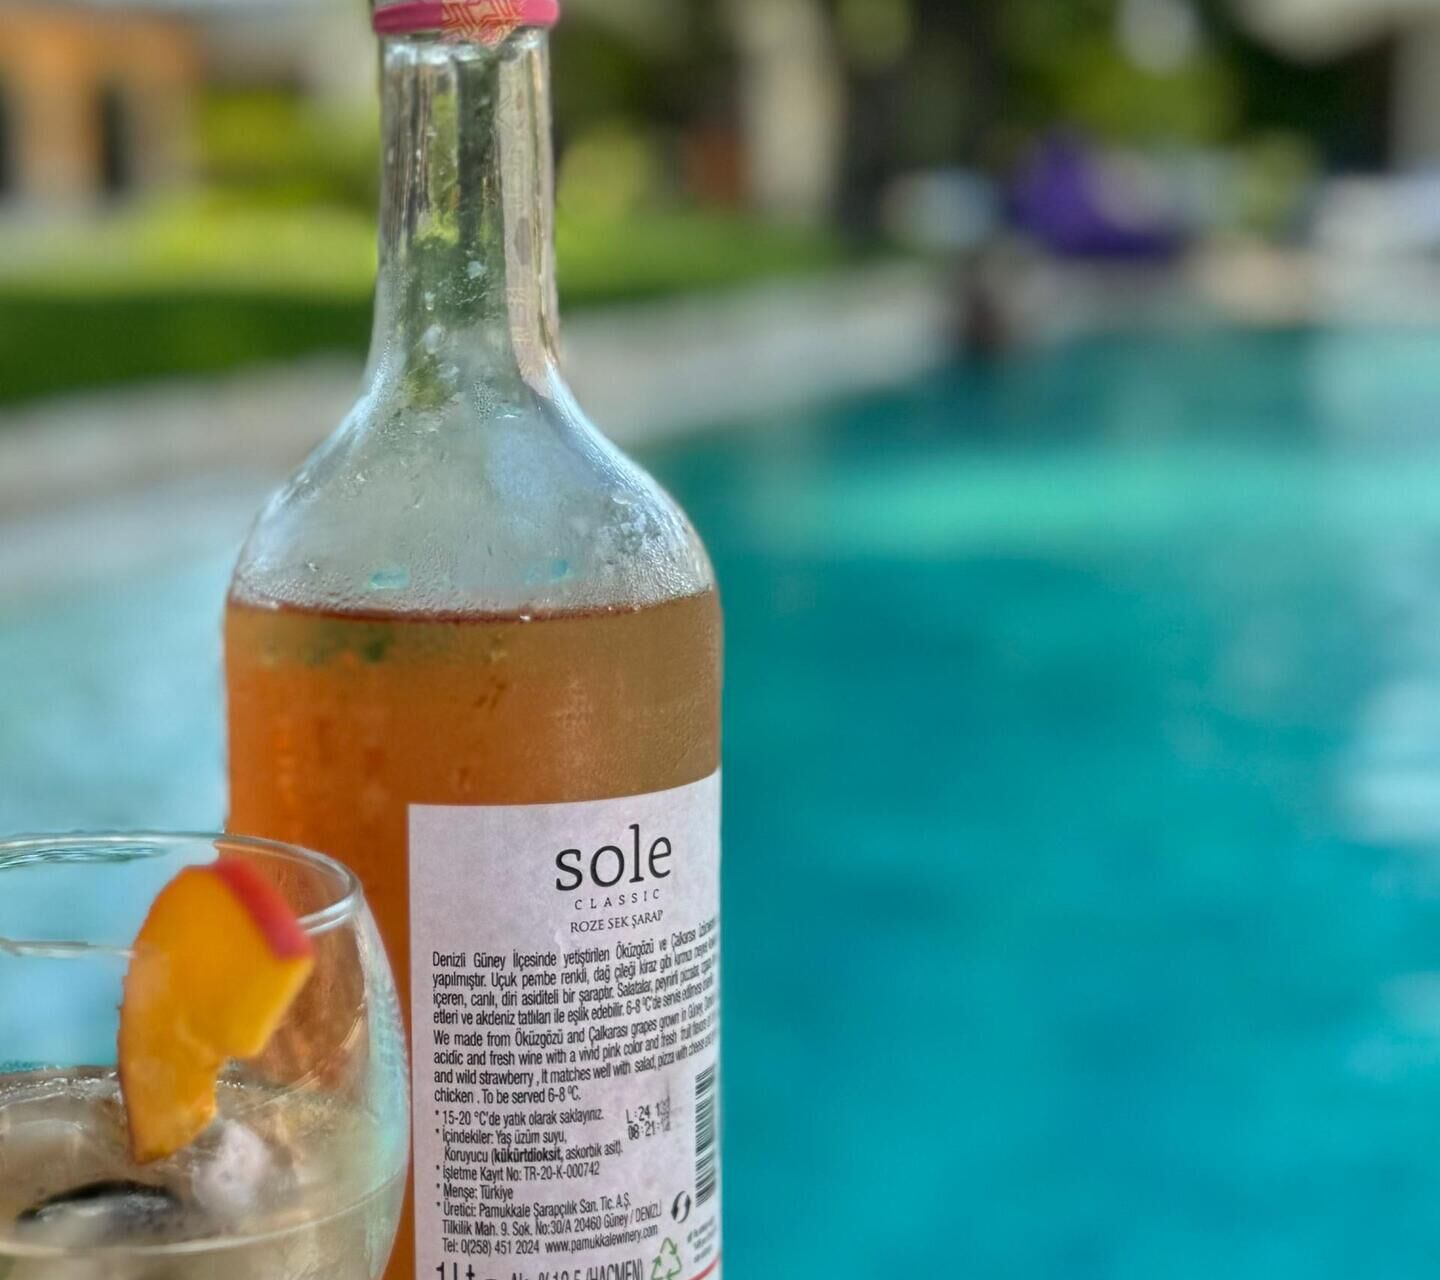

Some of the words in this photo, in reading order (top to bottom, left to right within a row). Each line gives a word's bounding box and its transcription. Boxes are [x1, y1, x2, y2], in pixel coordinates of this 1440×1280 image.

[555, 823, 673, 891] sole
[574, 888, 661, 910] CLASSIC
[570, 919, 604, 933] ROZE
[608, 916, 629, 929] SEK
[631, 910, 664, 929] ŞARAP
[432, 951, 466, 967] Denizli
[473, 952, 506, 971] Güney
[513, 949, 557, 971] İlçesinde
[563, 947, 610, 968] yetiştirilen
[616, 938, 655, 959] Öküzgözü
[659, 938, 667, 951] ve
[432, 971, 487, 991] yapılmıştır.
[491, 972, 518, 991] Uçuk
[521, 970, 557, 990] pembe
[561, 967, 589, 985] renkli,
[594, 964, 611, 986] dağ
[614, 963, 636, 982] çileği
[639, 960, 657, 975] kiraz
[432, 989, 468, 1008] içeren,
[471, 991, 498, 1008] canlı,
[502, 990, 517, 1006] diri
[521, 989, 559, 1006] asiditeli
[563, 988, 575, 1003] bir
[579, 985, 614, 1006] şaraptır.
[433, 1009, 459, 1024] etleri
[461, 1012, 473, 1025] ve
[476, 1010, 515, 1025] akdeniz
[554, 1008, 565, 1023] ile
[568, 1006, 589, 1025] eşlik
[592, 1002, 624, 1019] edebilir.
[626, 1000, 641, 1015] 6-8
[433, 1030, 450, 1045] We
[454, 1031, 482, 1047] made
[487, 1031, 511, 1047] from
[515, 1028, 563, 1049] Öküzgözü
[567, 1028, 585, 1044] and
[588, 1024, 628, 1048] Çalkarası
[631, 1019, 657, 1038] grapes
[660, 1013, 679, 1031] grown
[433, 1049, 464, 1065] acidic
[467, 1050, 486, 1065] and
[489, 1050, 515, 1066] fresh
[518, 1050, 543, 1065] wine
[545, 1048, 567, 1064] with
[569, 1050, 576, 1063] a
[578, 1045, 600, 1062] vivid
[602, 1040, 622, 1061] pink
[623, 1038, 643, 1057] color
[645, 1034, 659, 1051] and
[660, 1030, 677, 1048] fresh
[434, 1068, 453, 1084] and
[455, 1069, 476, 1084] wild
[479, 1070, 534, 1088] strawberry
[550, 1065, 591, 1083] matches
[592, 1061, 612, 1080] well
[613, 1060, 630, 1077] with
[634, 1055, 657, 1073] salad,
[658, 1050, 675, 1068] pizza
[434, 1086, 474, 1104] chicken
[481, 1089, 494, 1104] To
[496, 1089, 509, 1104] be
[512, 1088, 545, 1104] served
[548, 1085, 565, 1102] 6-8
[443, 1110, 471, 1126] 15-20
[503, 1110, 527, 1129] yatık
[528, 1109, 558, 1126] olarak
[559, 1108, 604, 1126] saklayınız.
[442, 1125, 494, 1146] İçindekiler:
[496, 1129, 511, 1148] Yaş
[514, 1129, 540, 1144] üzüm
[542, 1130, 567, 1147] suyu,
[444, 1147, 489, 1165] Koruyucu
[491, 1146, 564, 1166] (kükürtdioksit,
[565, 1144, 602, 1161] askorbik
[443, 1162, 477, 1182] İşletme
[480, 1166, 503, 1184] Kayıt
[506, 1166, 522, 1182] No:
[524, 1160, 600, 1182] TR-20-K-000742
[443, 1182, 478, 1202] Menşe:
[480, 1184, 514, 1202] Türkiye
[443, 1197, 476, 1217] Üretici:
[479, 1202, 531, 1218] Pamukkale
[533, 1200, 577, 1219] Şarapçılık
[579, 1198, 599, 1213] San.
[600, 1195, 614, 1211] Tic.
[442, 1219, 472, 1235] Tilkilik
[475, 1222, 499, 1236] Mah.
[501, 1222, 510, 1236] 9.
[512, 1222, 533, 1236] Sok.
[535, 1219, 572, 1235] No:30/A
[574, 1217, 602, 1233] 20460
[603, 1211, 628, 1232] Güney
[442, 1237, 459, 1253] Tel:
[461, 1239, 492, 1257] 0(258)
[495, 1240, 511, 1254] 451
[515, 1238, 540, 1254] 2024
[545, 1223, 658, 1255] www.pamukkalewinery.com
